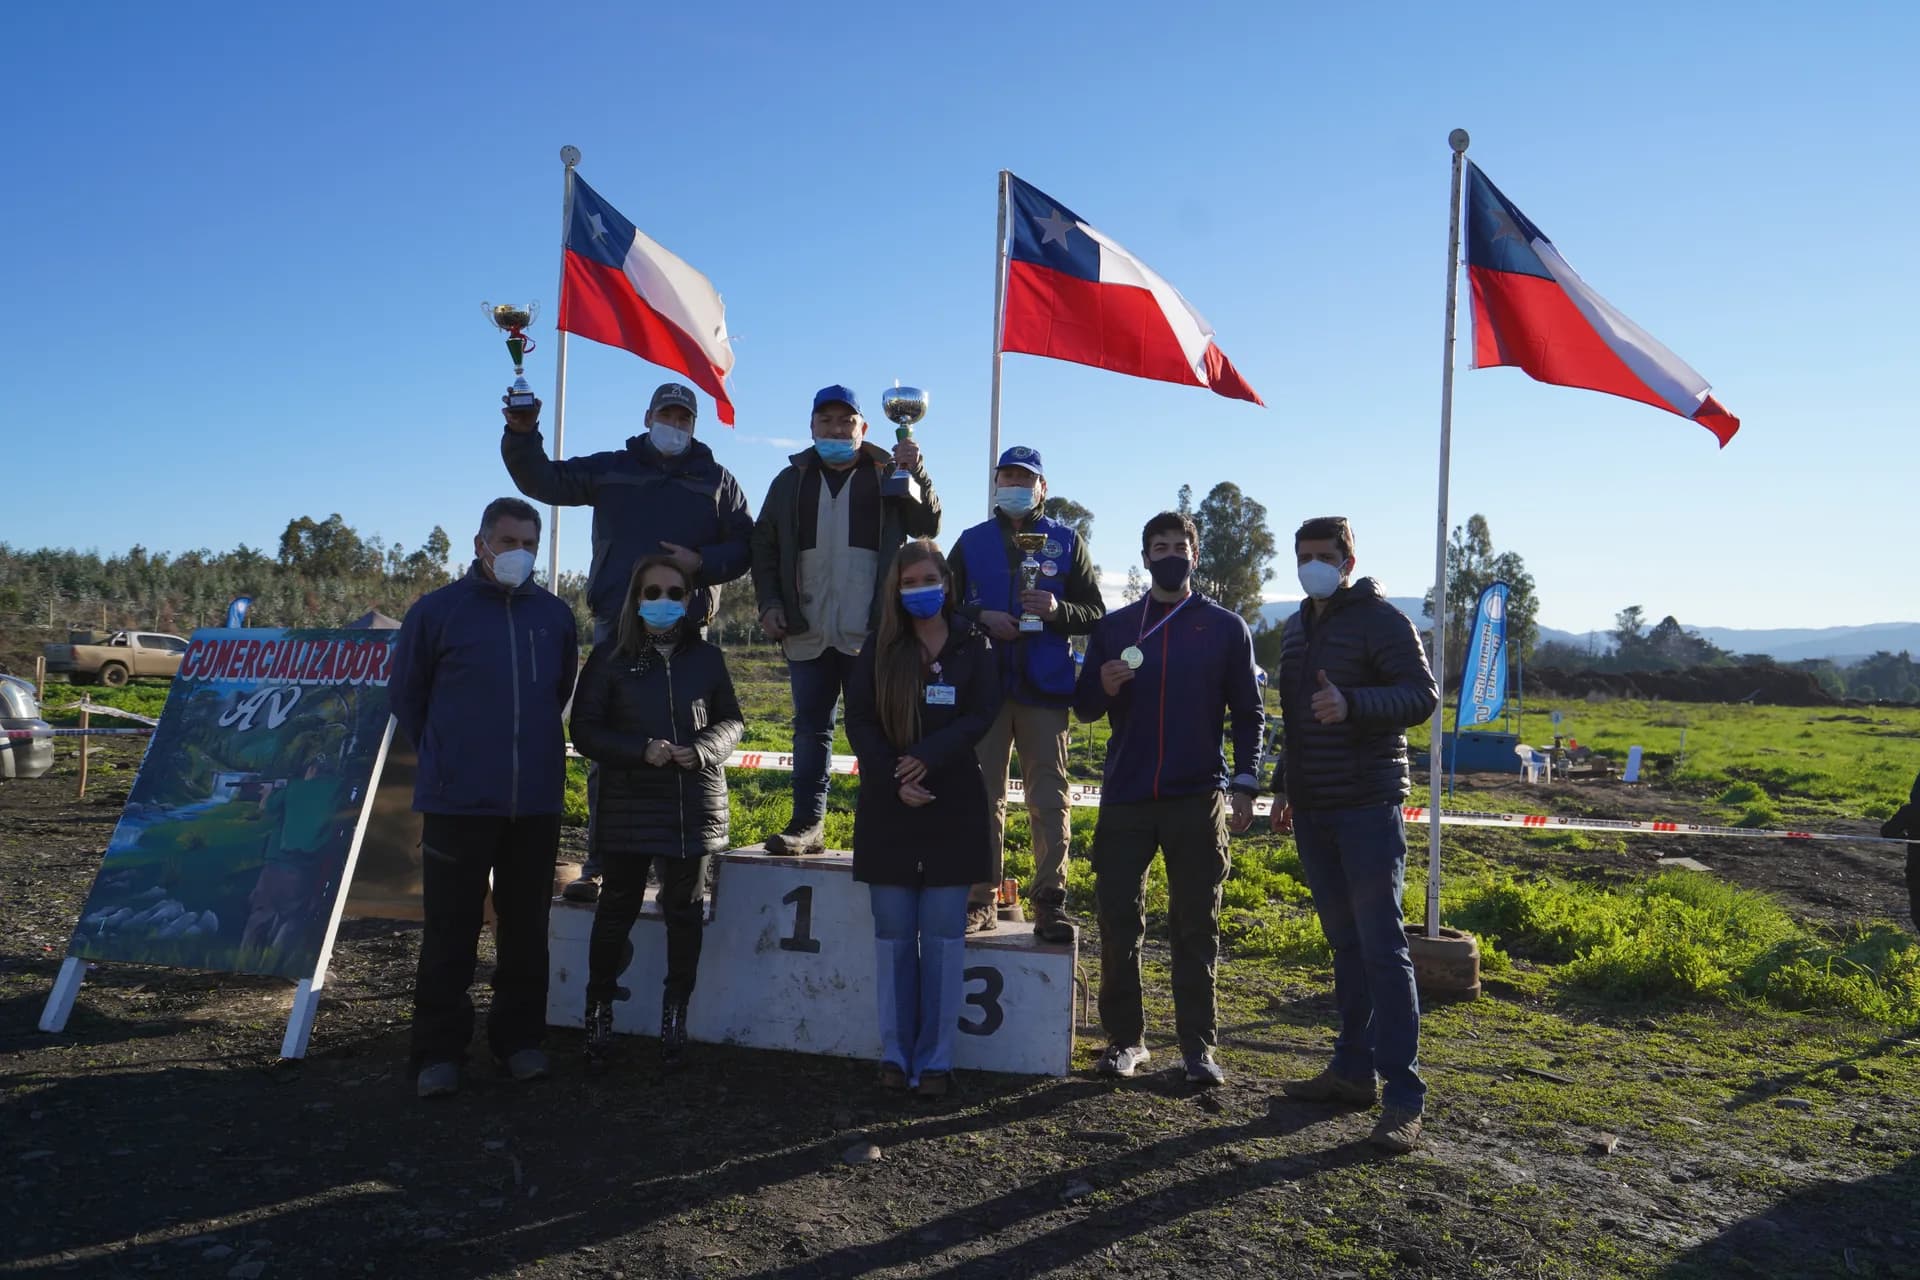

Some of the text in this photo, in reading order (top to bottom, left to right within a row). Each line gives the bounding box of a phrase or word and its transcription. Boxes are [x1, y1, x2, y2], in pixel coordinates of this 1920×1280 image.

[218, 686, 302, 731] AV
[779, 885, 821, 954] 1
[957, 966, 1004, 1036] 3
